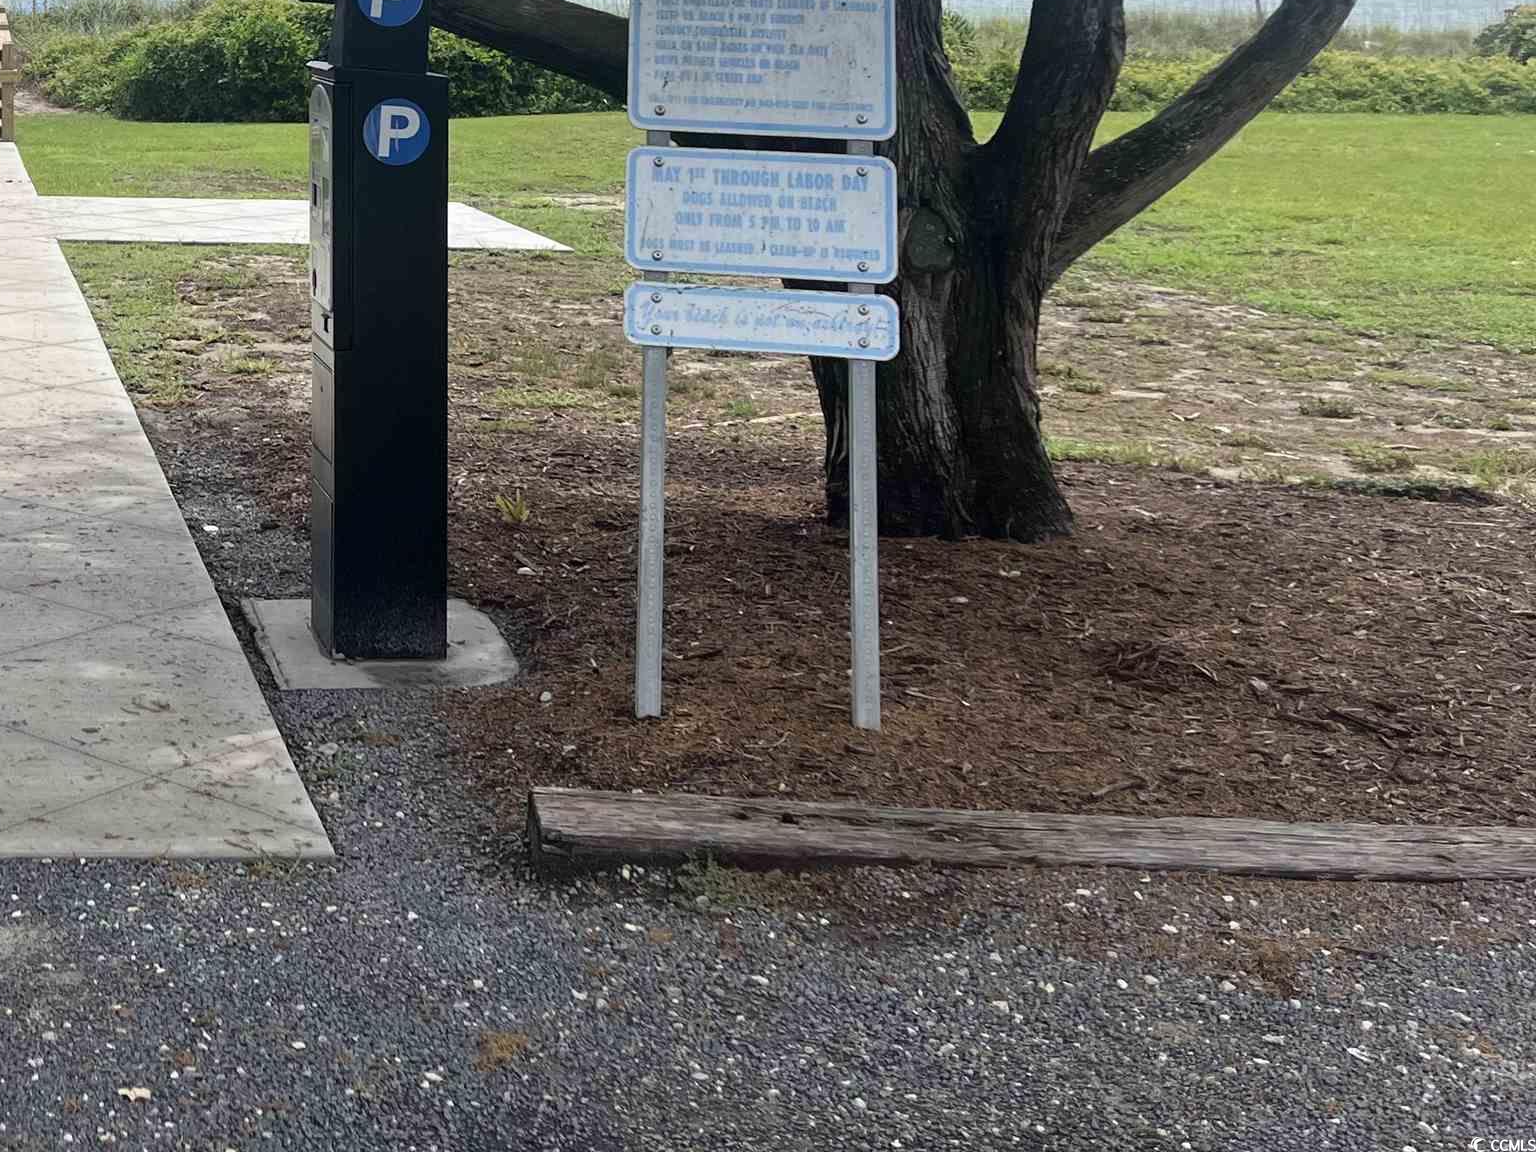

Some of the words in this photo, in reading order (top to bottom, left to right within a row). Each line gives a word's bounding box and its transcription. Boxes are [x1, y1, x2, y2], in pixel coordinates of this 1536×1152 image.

[377, 105, 420, 159] P
[651, 167, 680, 183] MAY
[712, 168, 779, 187] THROUGH
[787, 172, 834, 191] LABOR
[842, 174, 869, 192] DAY
[674, 211, 703, 226] ONLY
[709, 214, 743, 228] FROM
